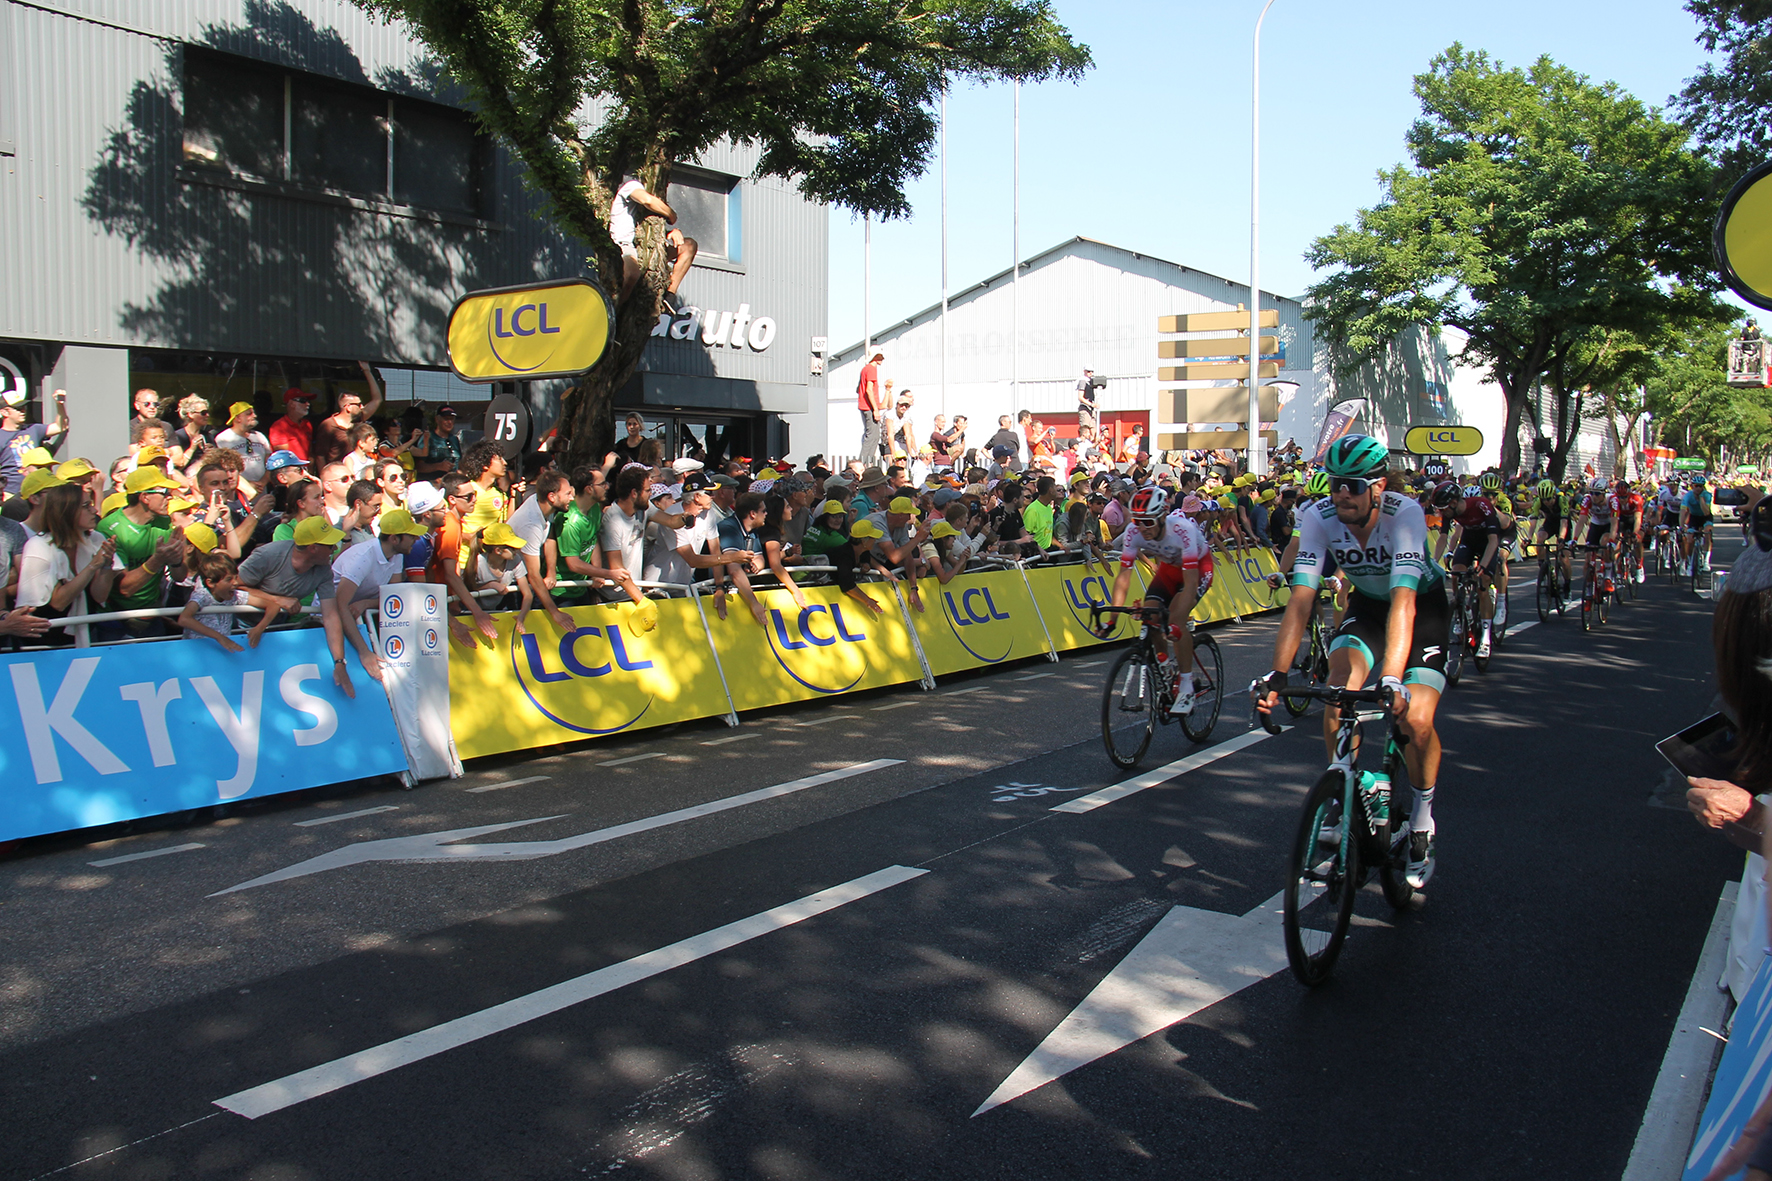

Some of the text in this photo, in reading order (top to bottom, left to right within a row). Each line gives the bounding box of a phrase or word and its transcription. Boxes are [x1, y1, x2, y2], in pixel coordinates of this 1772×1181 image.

[494, 302, 560, 338] LCL
[892, 324, 1136, 360] CARROSSERIE
[494, 412, 517, 441] 75
[1429, 431, 1461, 443] LCL
[1426, 465, 1443, 474] 100
[1316, 500, 1334, 511] BO
[1236, 557, 1269, 584] LCL
[1335, 545, 1392, 564] BORA
[943, 587, 1011, 626] LCL
[1064, 575, 1113, 609] LCL
[770, 603, 866, 650] LCL
[520, 624, 654, 683] LCL
[8, 656, 339, 799] Krys
